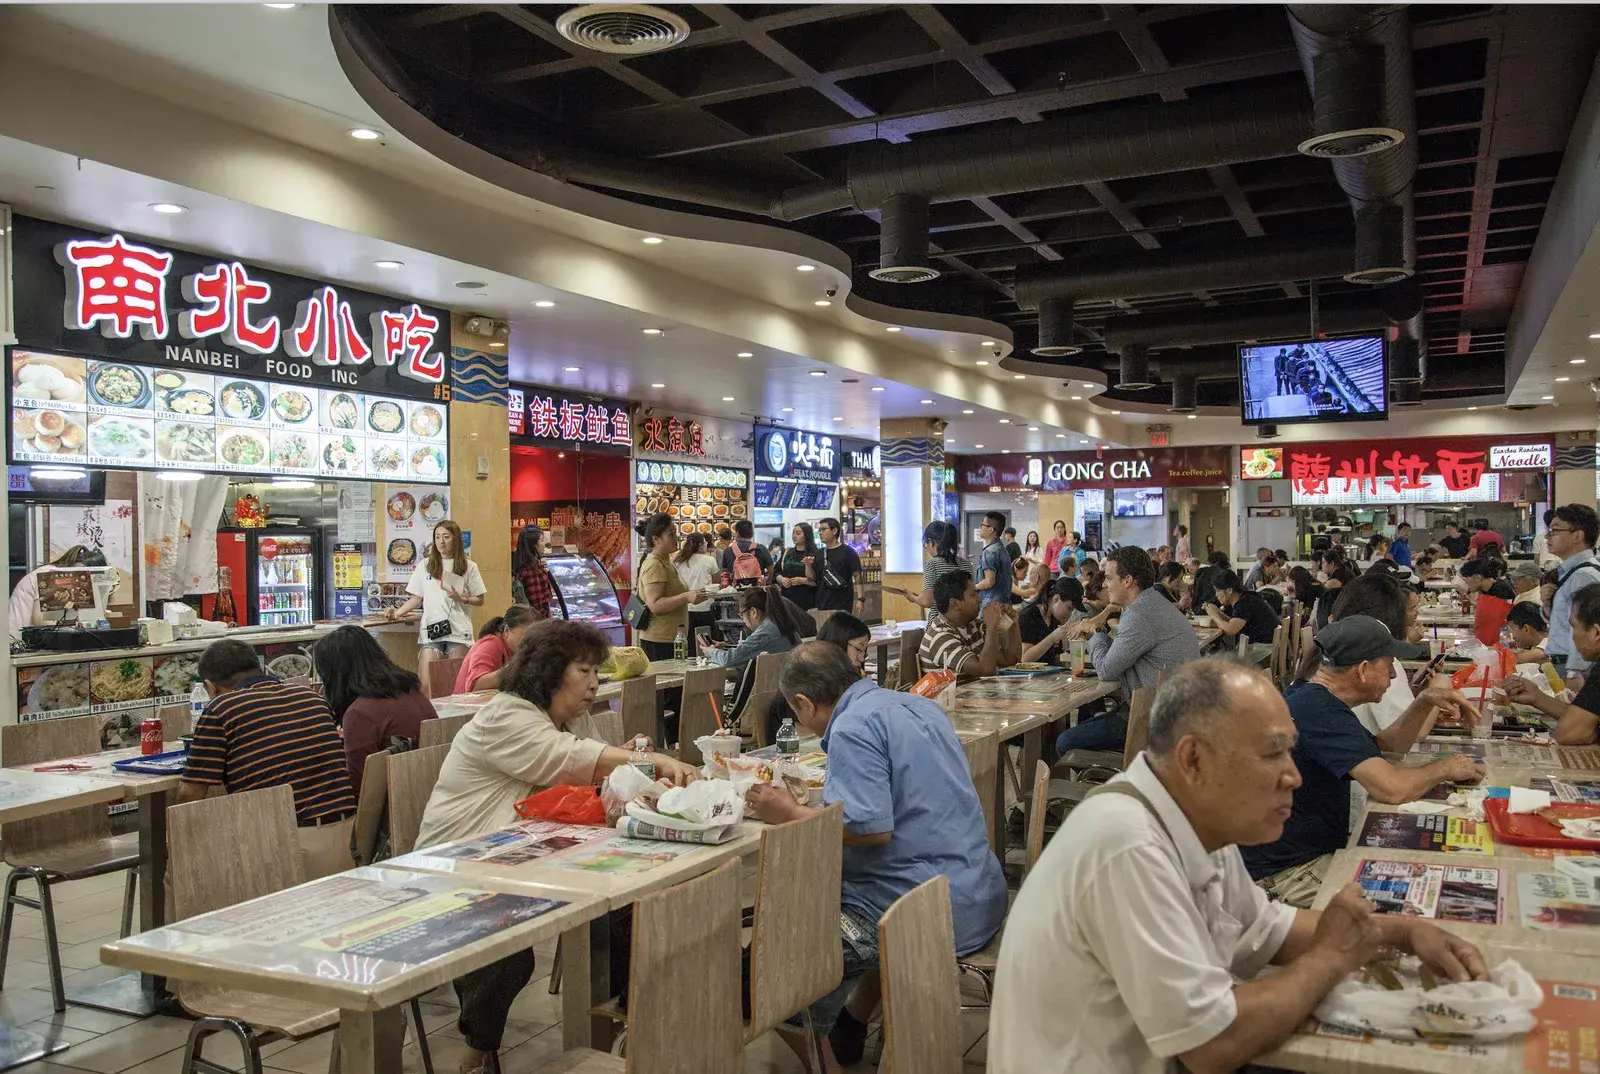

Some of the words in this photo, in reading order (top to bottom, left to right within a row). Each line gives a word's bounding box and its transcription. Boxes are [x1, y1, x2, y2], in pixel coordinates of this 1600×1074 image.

[66, 233, 444, 384] 南北小吃
[165, 345, 240, 370] NANBEI
[266, 359, 313, 379] FOOD
[331, 368, 358, 385] INC
[433, 384, 450, 401] #6
[529, 395, 632, 446] 铁板鱿鱼
[1151, 432, 1168, 446] EXIT
[851, 451, 872, 470] THAI
[1495, 453, 1548, 468] Noodle
[810, 470, 832, 480] NOODLE
[1048, 462, 1105, 481] GONG
[1109, 460, 1152, 480] CHA
[1168, 468, 1223, 478] Tea.coffee.juice
[1290, 449, 1486, 496] 蘭州拉面
[142, 729, 162, 742] Cola
